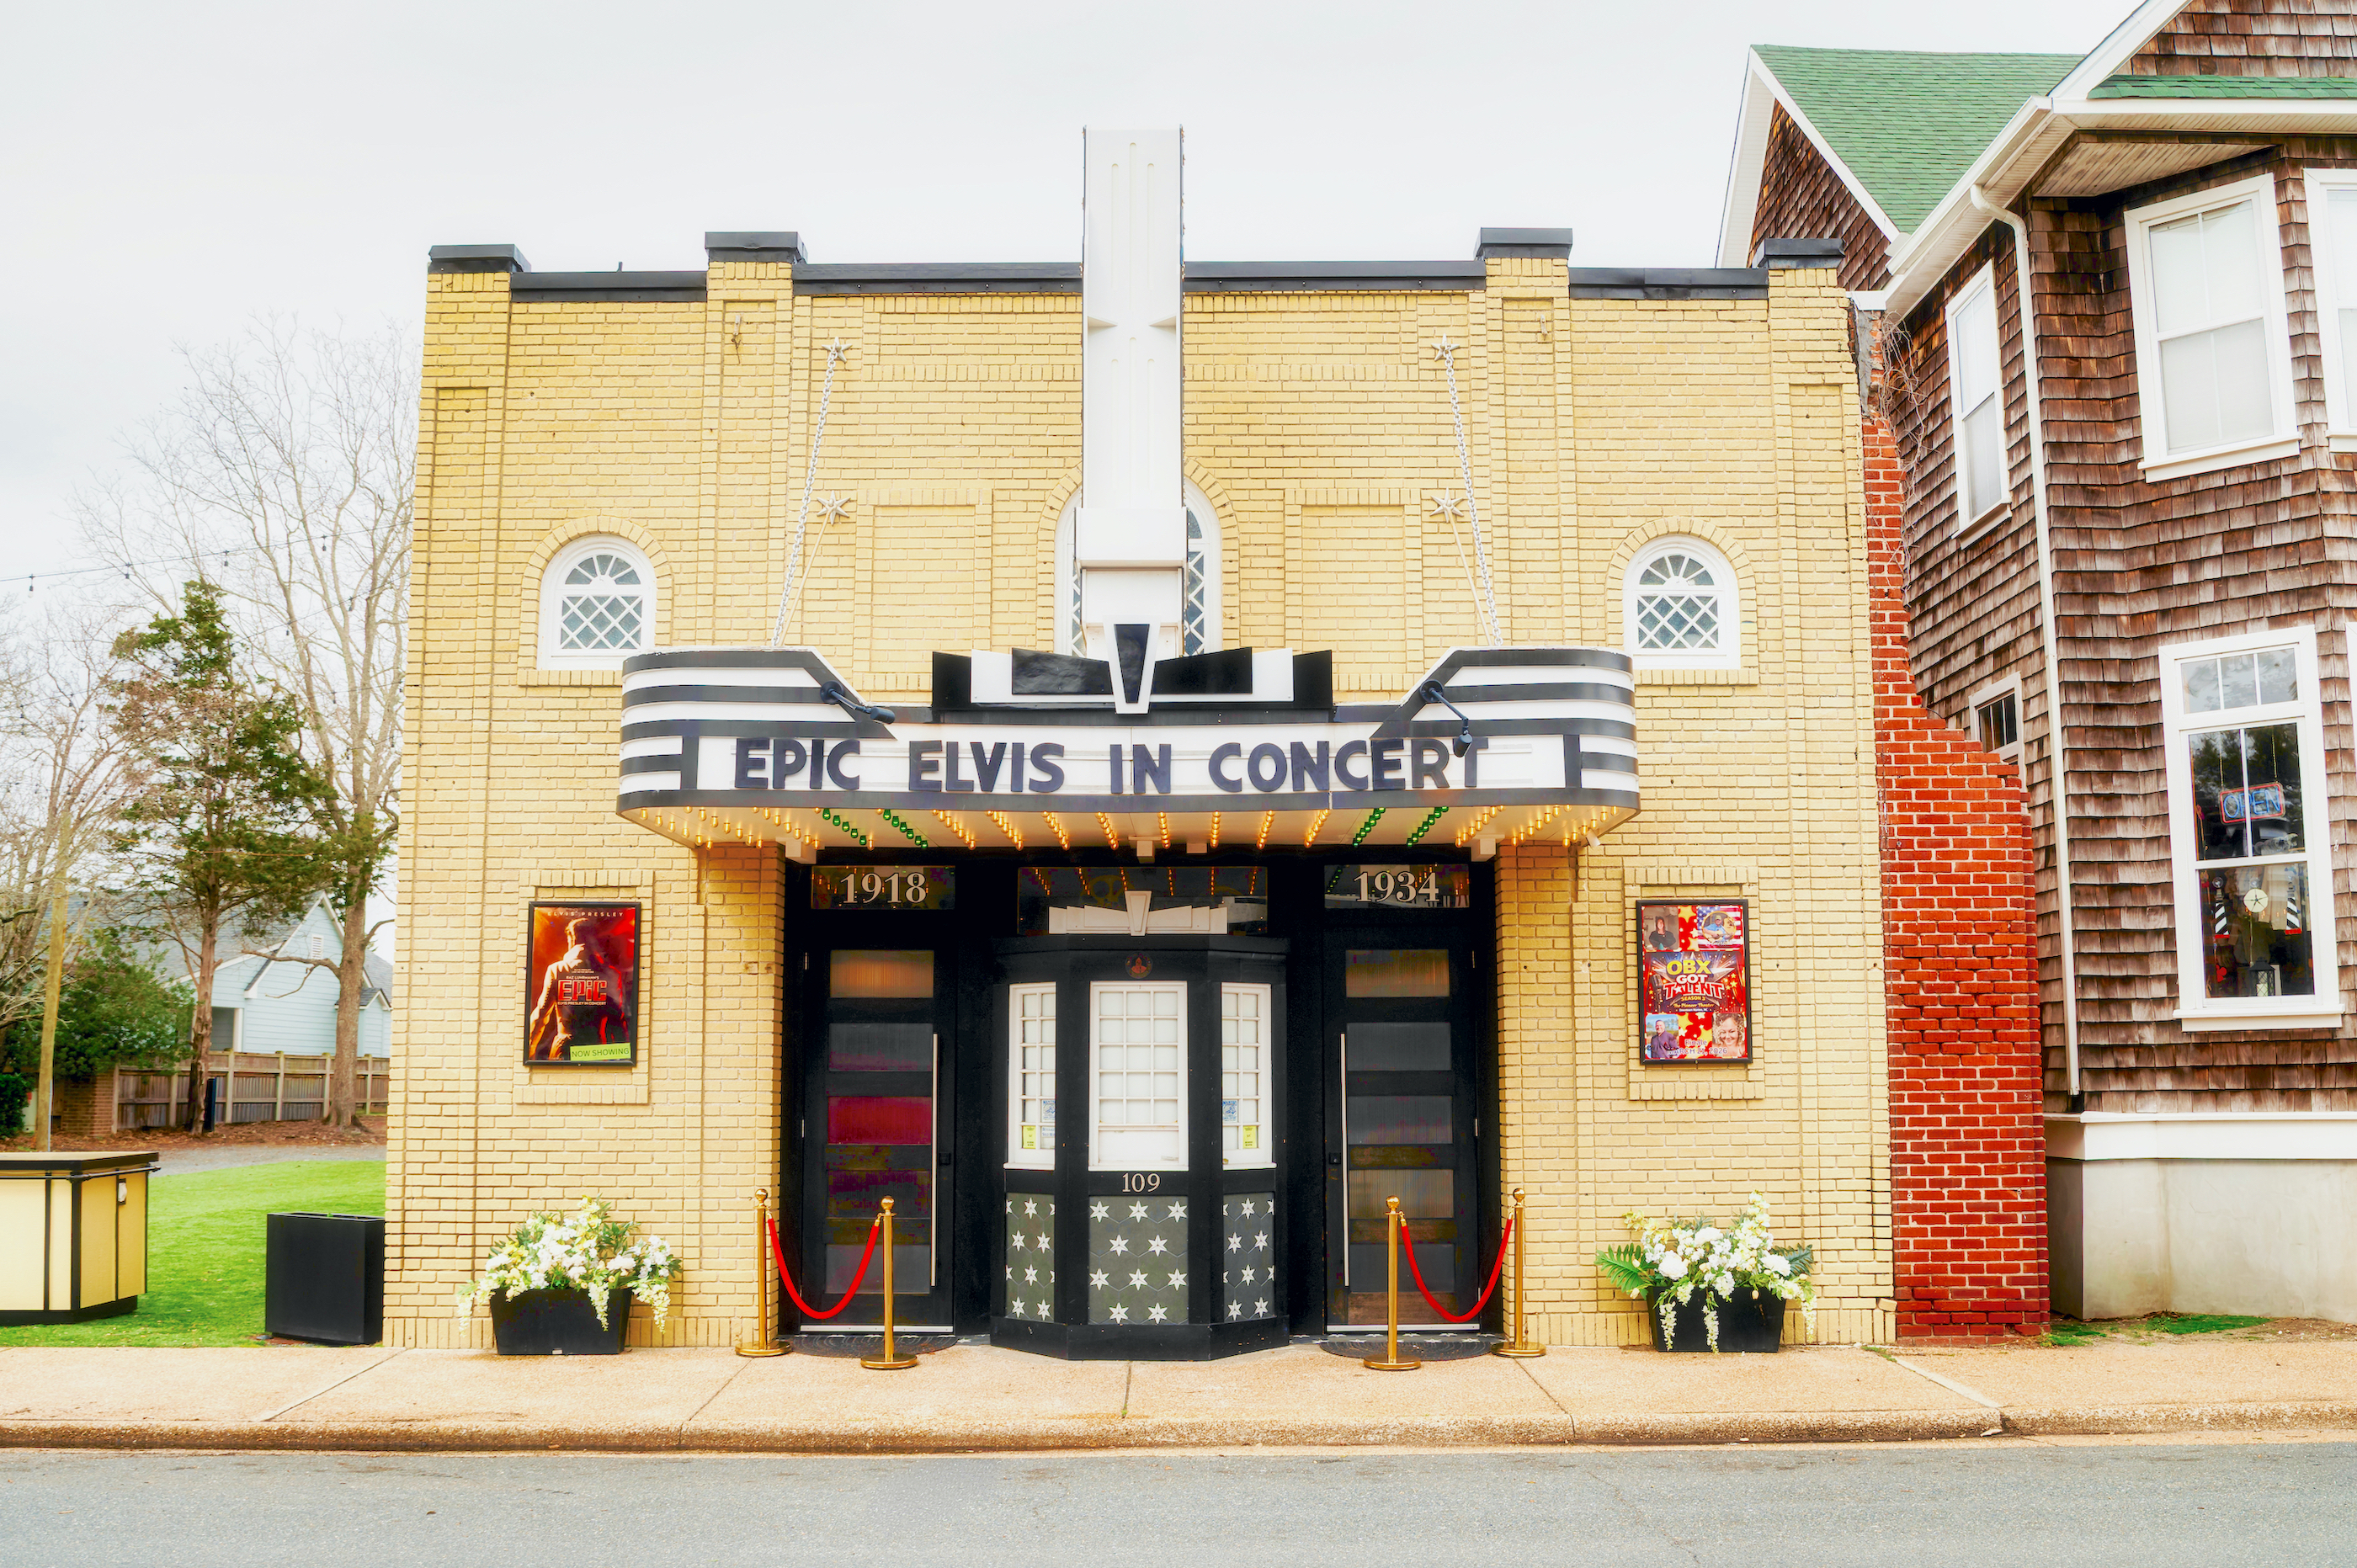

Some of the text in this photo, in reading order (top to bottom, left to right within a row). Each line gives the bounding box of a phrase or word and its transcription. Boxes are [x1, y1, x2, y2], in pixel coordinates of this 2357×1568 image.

[735, 736, 1489, 794] EPIC ELVIS IN CONCERT
[2223, 788, 2280, 818] OPEN
[840, 872, 927, 904] 1918
[1354, 871, 1440, 902] 1934
[1667, 959, 1712, 975] OBX
[1676, 974, 1708, 984] GOT
[1663, 981, 1725, 1000] TALENT
[592, 1048, 630, 1057] SHOWING
[1122, 1172, 1161, 1193] 109
